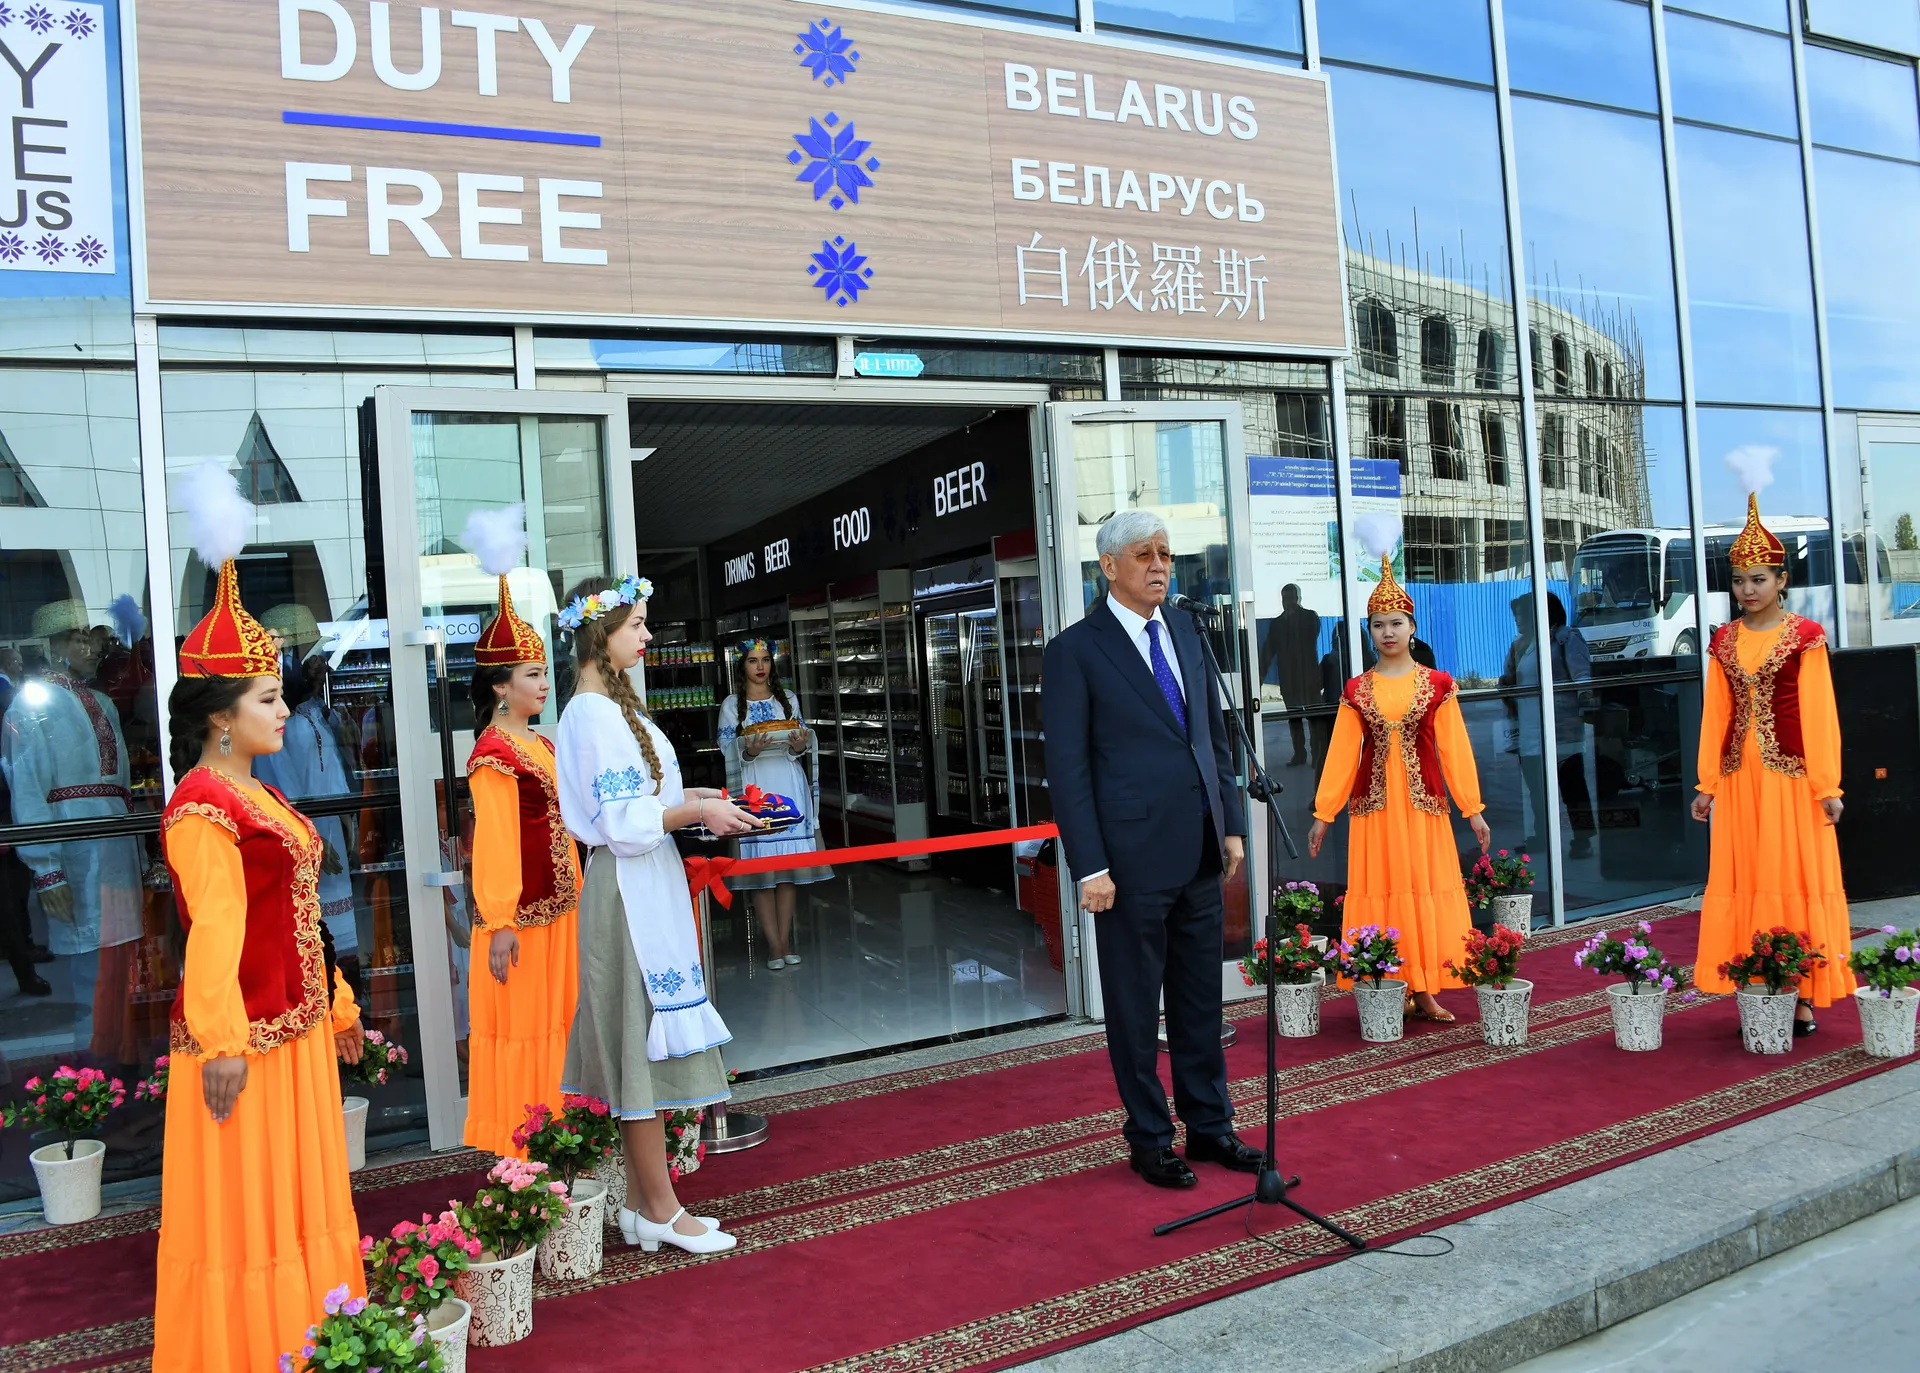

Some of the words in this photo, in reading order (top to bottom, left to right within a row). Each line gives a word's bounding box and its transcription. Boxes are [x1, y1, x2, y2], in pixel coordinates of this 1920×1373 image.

[279, 0, 595, 104] DUTY
[1004, 63, 1259, 140] BELARUS
[285, 161, 608, 266] FREE
[1011, 158, 1265, 223] БЕЛАРУСЬ
[1015, 231, 1269, 322] 白俄羅斯
[933, 461, 987, 517] BEER
[724, 552, 755, 587] DRINKS
[764, 538, 791, 574] BEER
[833, 506, 871, 550] FOOD
